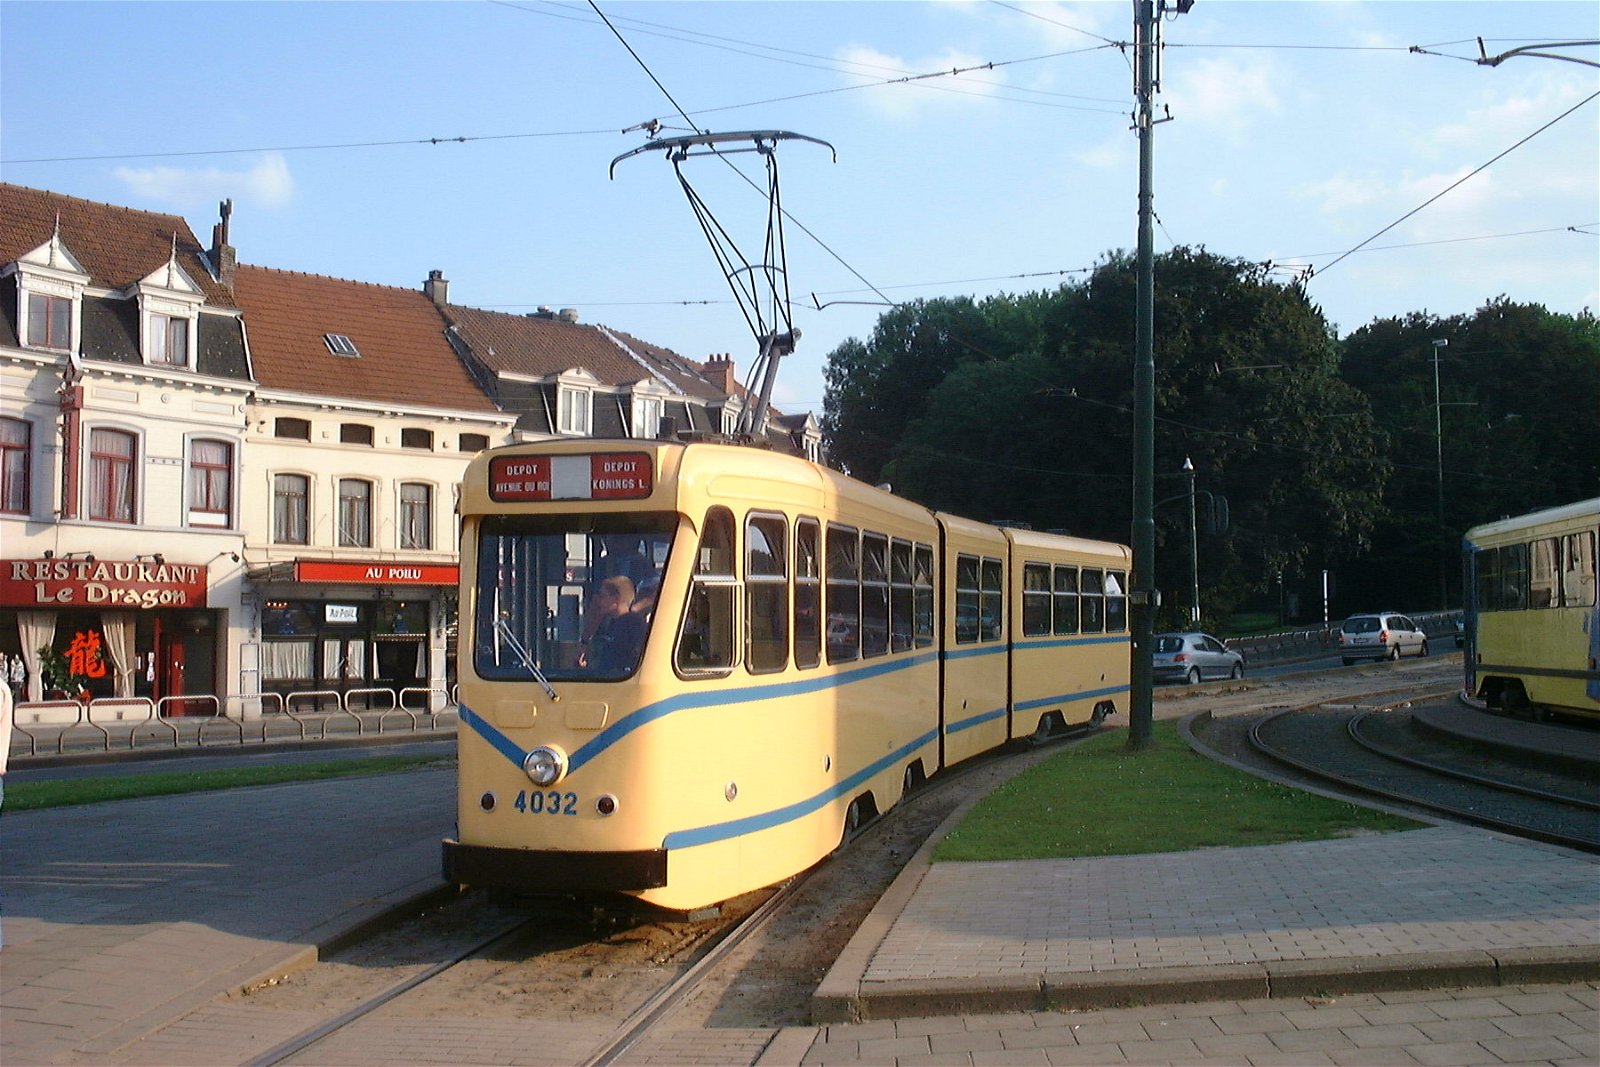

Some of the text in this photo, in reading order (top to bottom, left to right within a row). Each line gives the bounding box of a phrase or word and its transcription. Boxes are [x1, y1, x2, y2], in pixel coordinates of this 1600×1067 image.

[604, 461, 637, 473] DEPOT
[592, 479, 635, 491] KONINGS
[11, 562, 198, 584] RESTAURANT
[366, 568, 422, 579] AU POILU
[35, 582, 186, 608] Le Dragon
[64, 630, 105, 678] 龍
[514, 789, 577, 815] 4032
